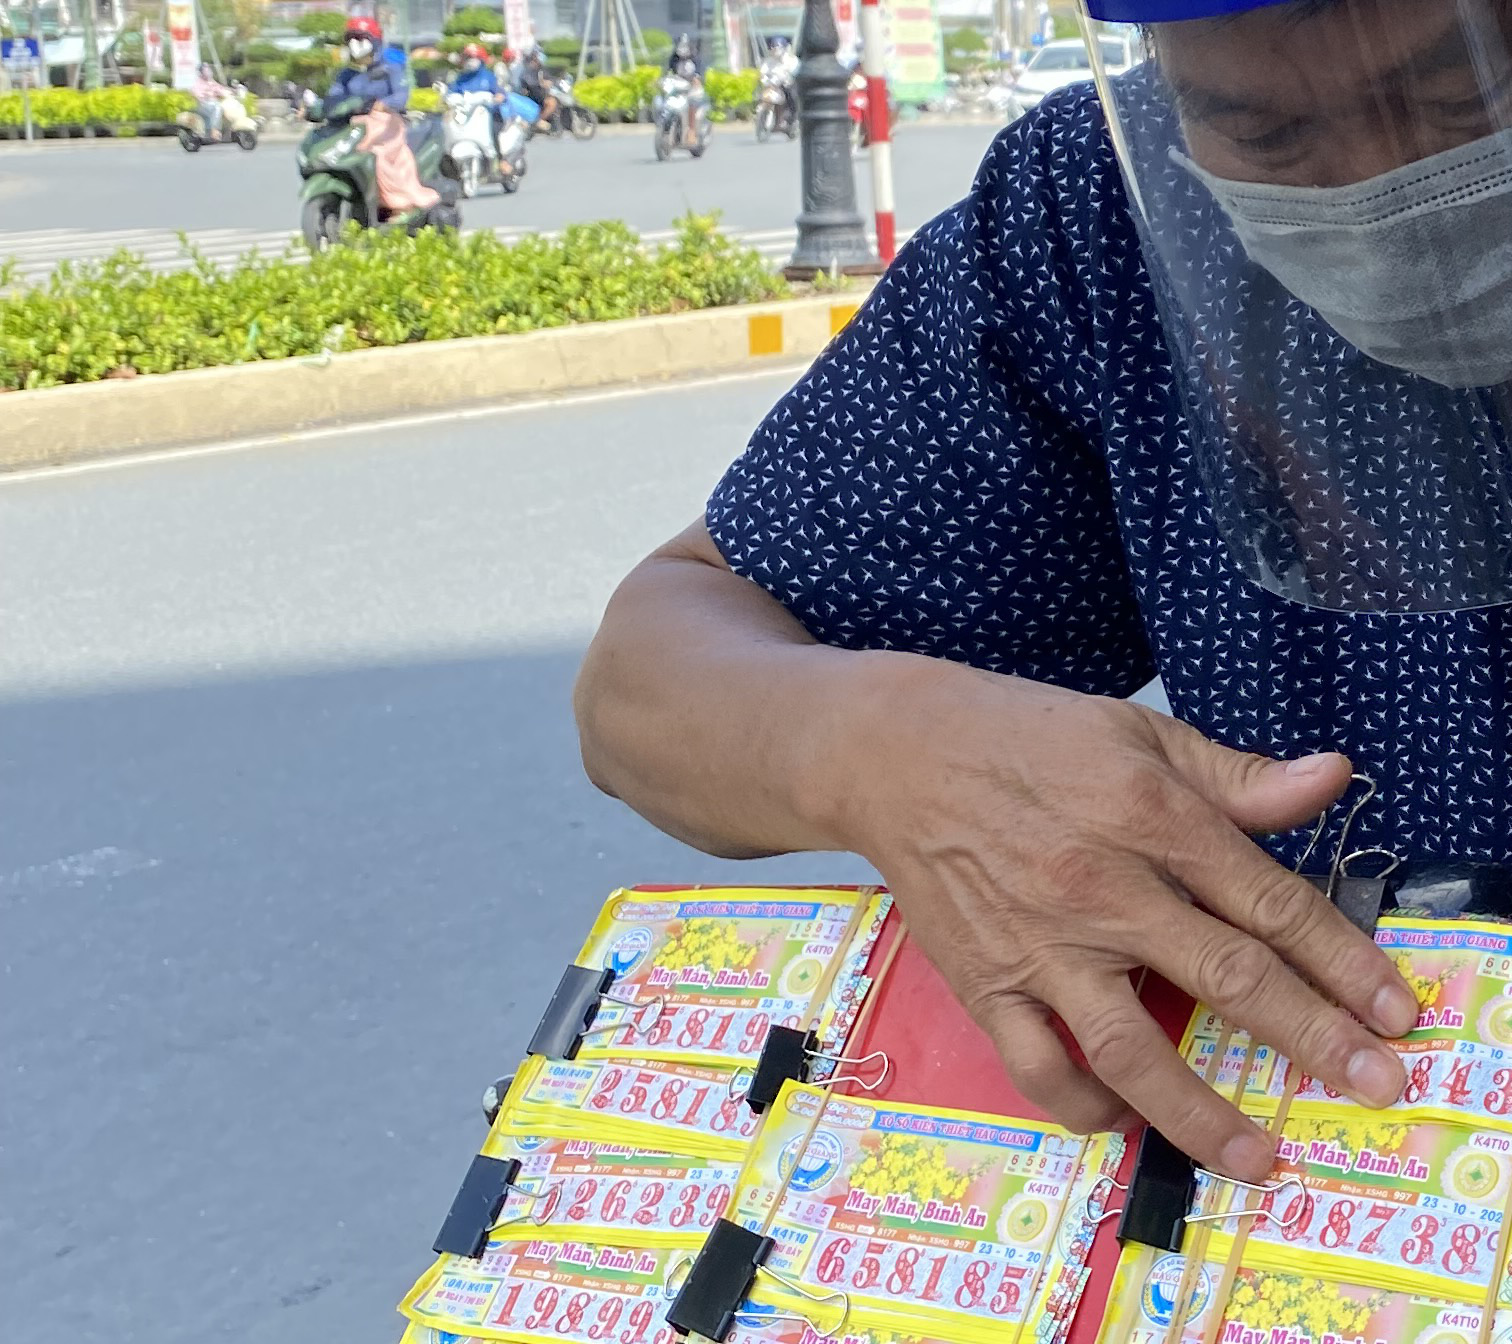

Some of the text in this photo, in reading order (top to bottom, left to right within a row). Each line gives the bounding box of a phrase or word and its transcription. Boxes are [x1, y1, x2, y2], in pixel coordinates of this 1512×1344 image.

[1467, 936, 1507, 950] GIANG
[998, 1132, 1034, 1146] GIANG
[1473, 1135, 1510, 1152] K4T10
[1357, 1150, 1400, 1178] Bình
[1404, 1161, 1429, 1181] An
[1027, 1182, 1060, 1197] K4T10
[537, 1177, 731, 1228] 126239
[846, 1190, 878, 1215] May
[923, 1205, 960, 1224] Bình
[963, 1209, 987, 1228] An
[816, 1236, 1028, 1316] 658185
[1441, 1311, 1480, 1329] K4T10
